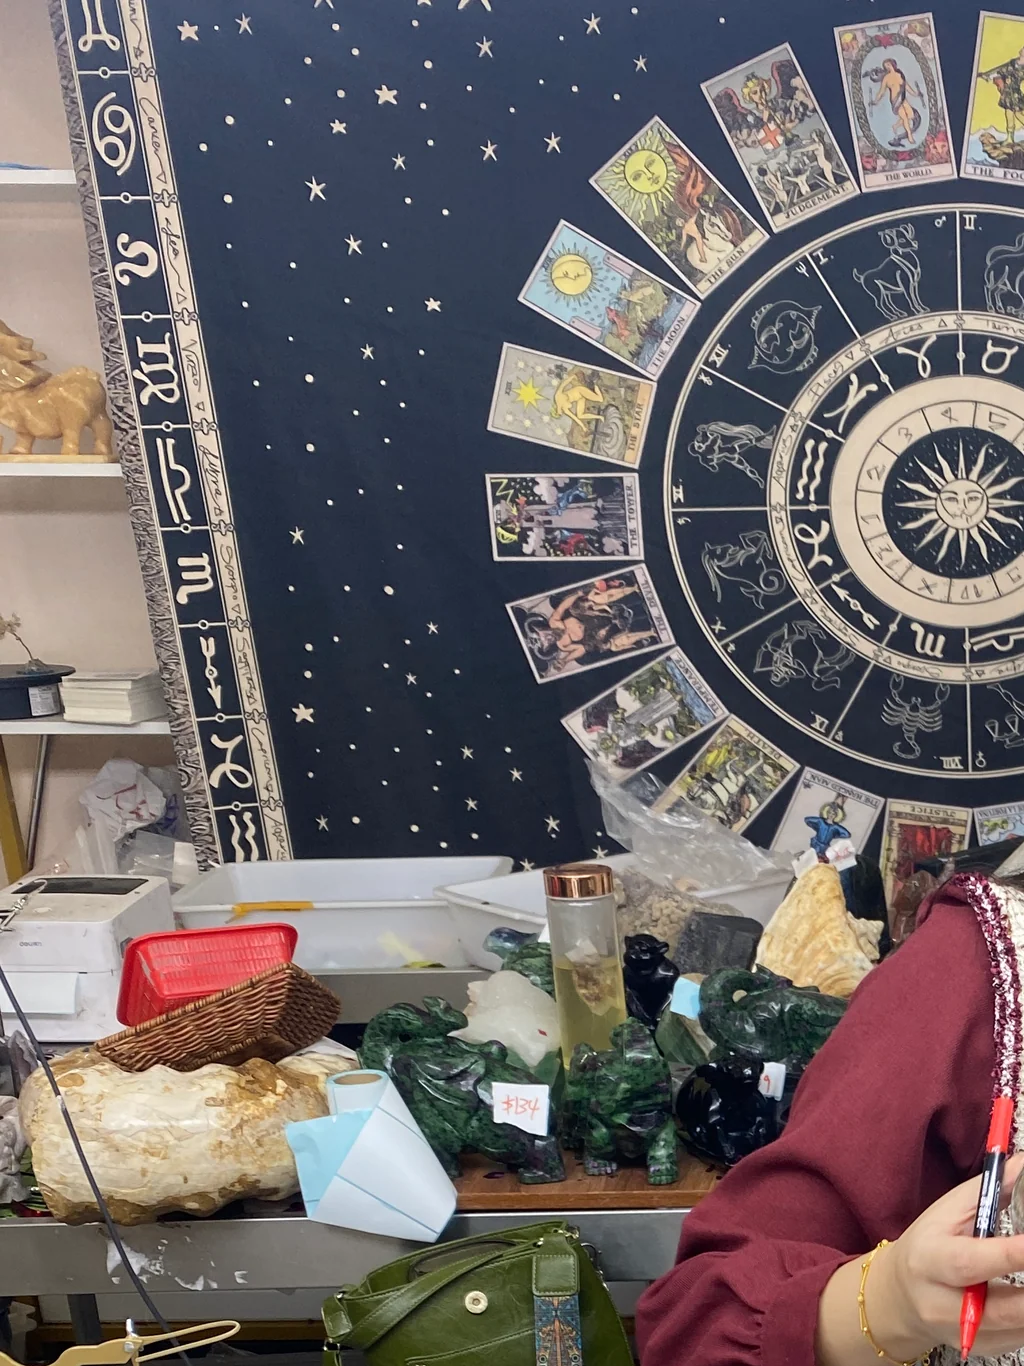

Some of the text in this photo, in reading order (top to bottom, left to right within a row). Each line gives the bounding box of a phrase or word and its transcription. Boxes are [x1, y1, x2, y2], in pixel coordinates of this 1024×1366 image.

[972, 166, 994, 177] THE
[650, 347, 667, 368] THE
[625, 402, 645, 452] THE STAR
[628, 527, 637, 547] THE
[653, 614, 667, 634] THE
[501, 1097, 541, 1121] $134
